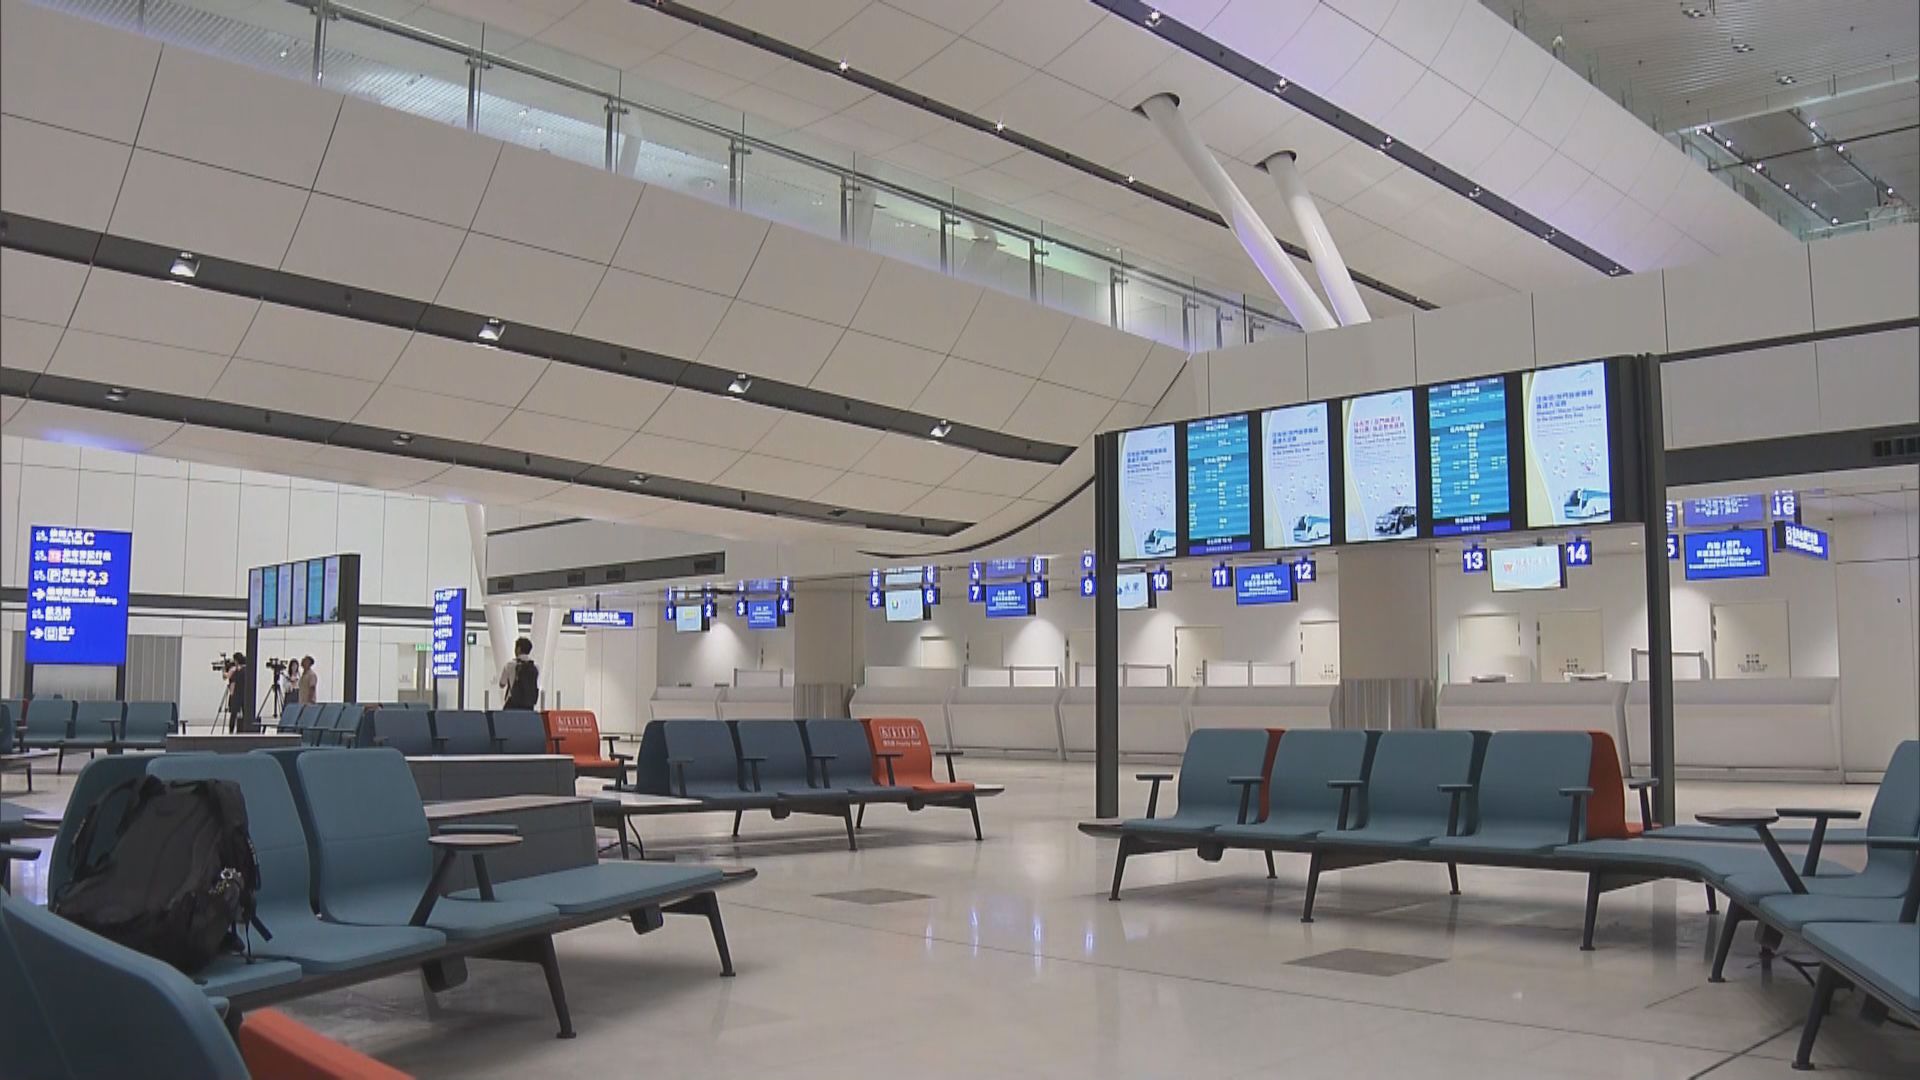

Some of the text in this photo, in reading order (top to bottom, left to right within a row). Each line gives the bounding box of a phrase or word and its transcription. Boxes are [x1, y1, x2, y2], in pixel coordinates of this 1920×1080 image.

[84, 532, 95, 545] C
[1464, 552, 1483, 569] 13
[1567, 544, 1587, 563] 14
[87, 570, 108, 586] 2,3
[1214, 570, 1226, 585] 11
[1295, 564, 1312, 579] 12
[1084, 579, 1093, 593] 9
[1153, 573, 1167, 589] 10
[927, 590, 934, 603] 6
[972, 586, 979, 600] 7
[1034, 582, 1041, 597] 8
[782, 600, 788, 611] 4
[872, 592, 879, 605] 5
[668, 608, 672, 619] 1
[706, 604, 711, 617] 2
[738, 602, 744, 615] 3
